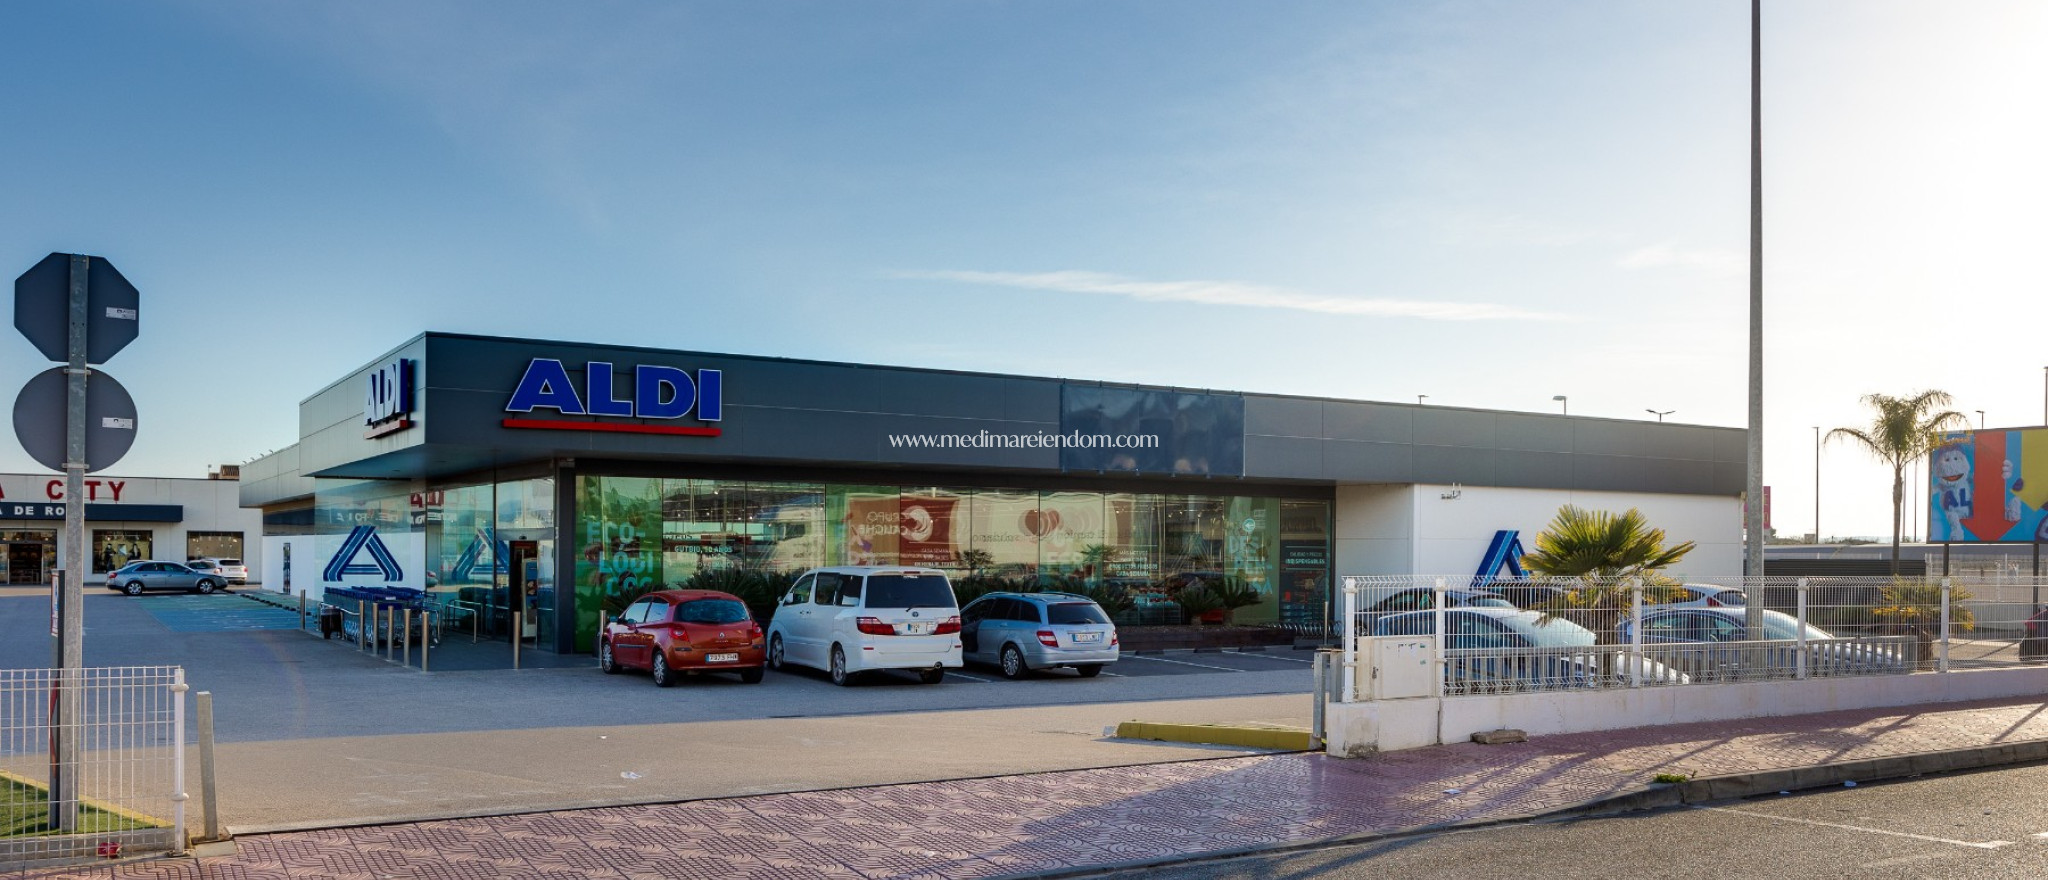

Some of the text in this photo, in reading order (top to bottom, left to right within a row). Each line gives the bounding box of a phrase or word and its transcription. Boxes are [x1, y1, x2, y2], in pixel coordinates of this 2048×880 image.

[364, 358, 408, 427] ALDI
[505, 357, 722, 421] ALDI
[14, 506, 34, 516] DE
[46, 480, 126, 501] CTY
